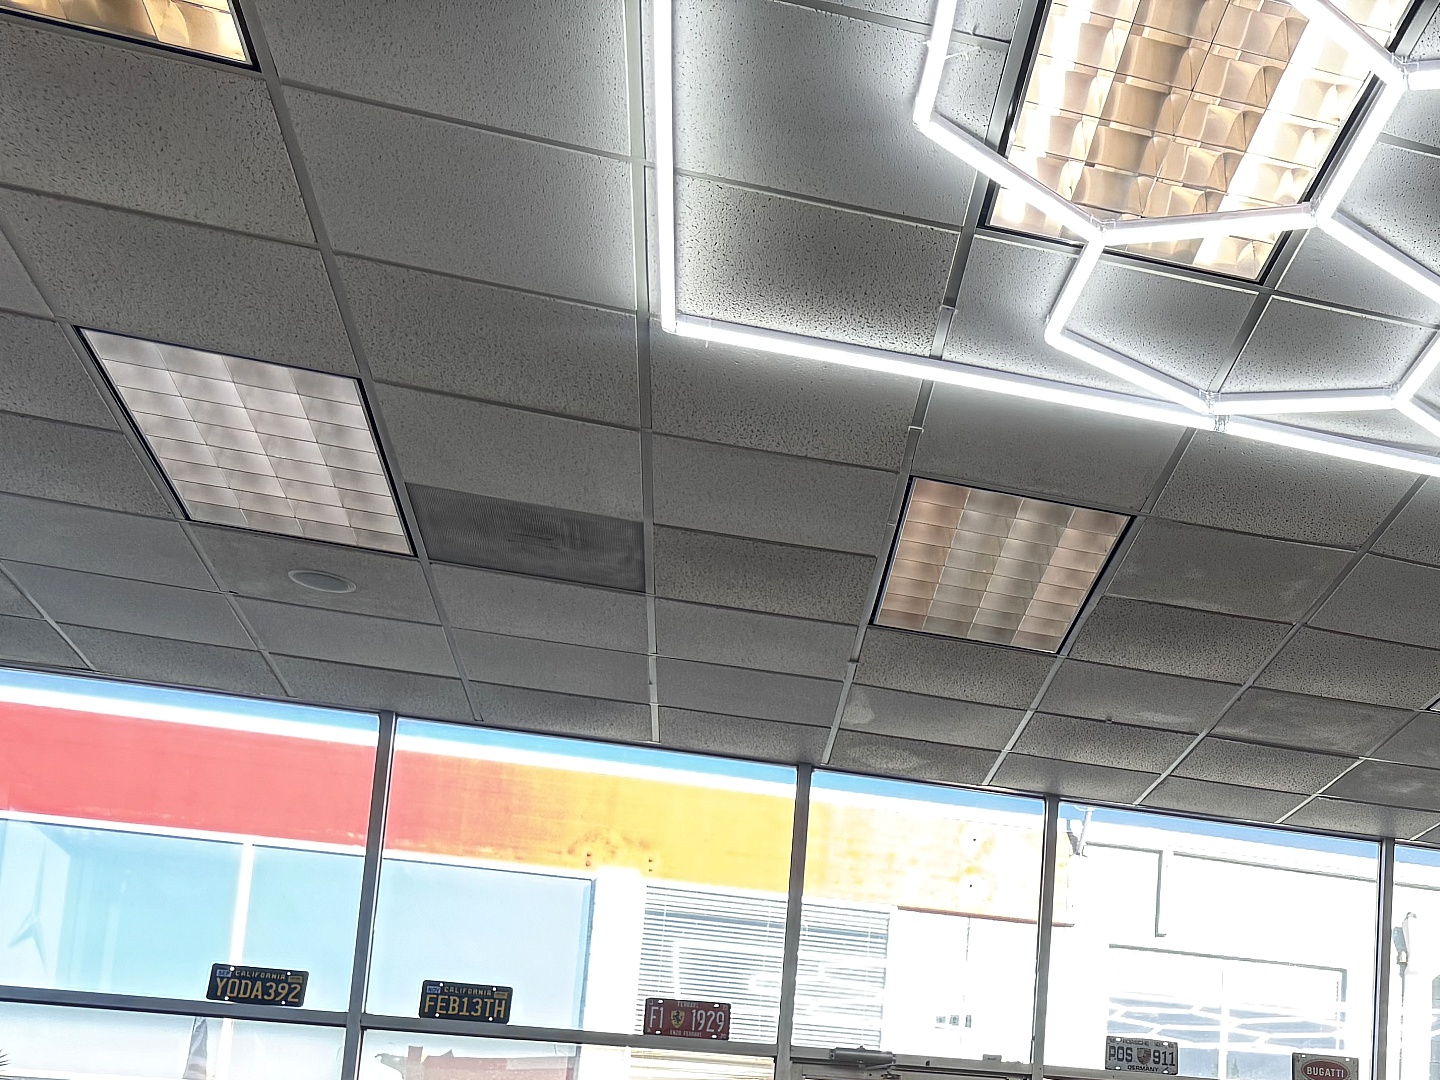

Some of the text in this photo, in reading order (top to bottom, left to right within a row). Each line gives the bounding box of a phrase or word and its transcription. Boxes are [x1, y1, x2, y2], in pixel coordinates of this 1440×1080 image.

[235, 969, 286, 980] CALIFORNIA
[216, 977, 301, 1002] YODA392
[444, 986, 492, 996] CALIFORNIA
[424, 994, 506, 1018] FEB13TH
[649, 1006, 725, 1033] F1 1929
[1152, 1049, 1176, 1067] 911
[1306, 1066, 1344, 1078] BUGATTI
